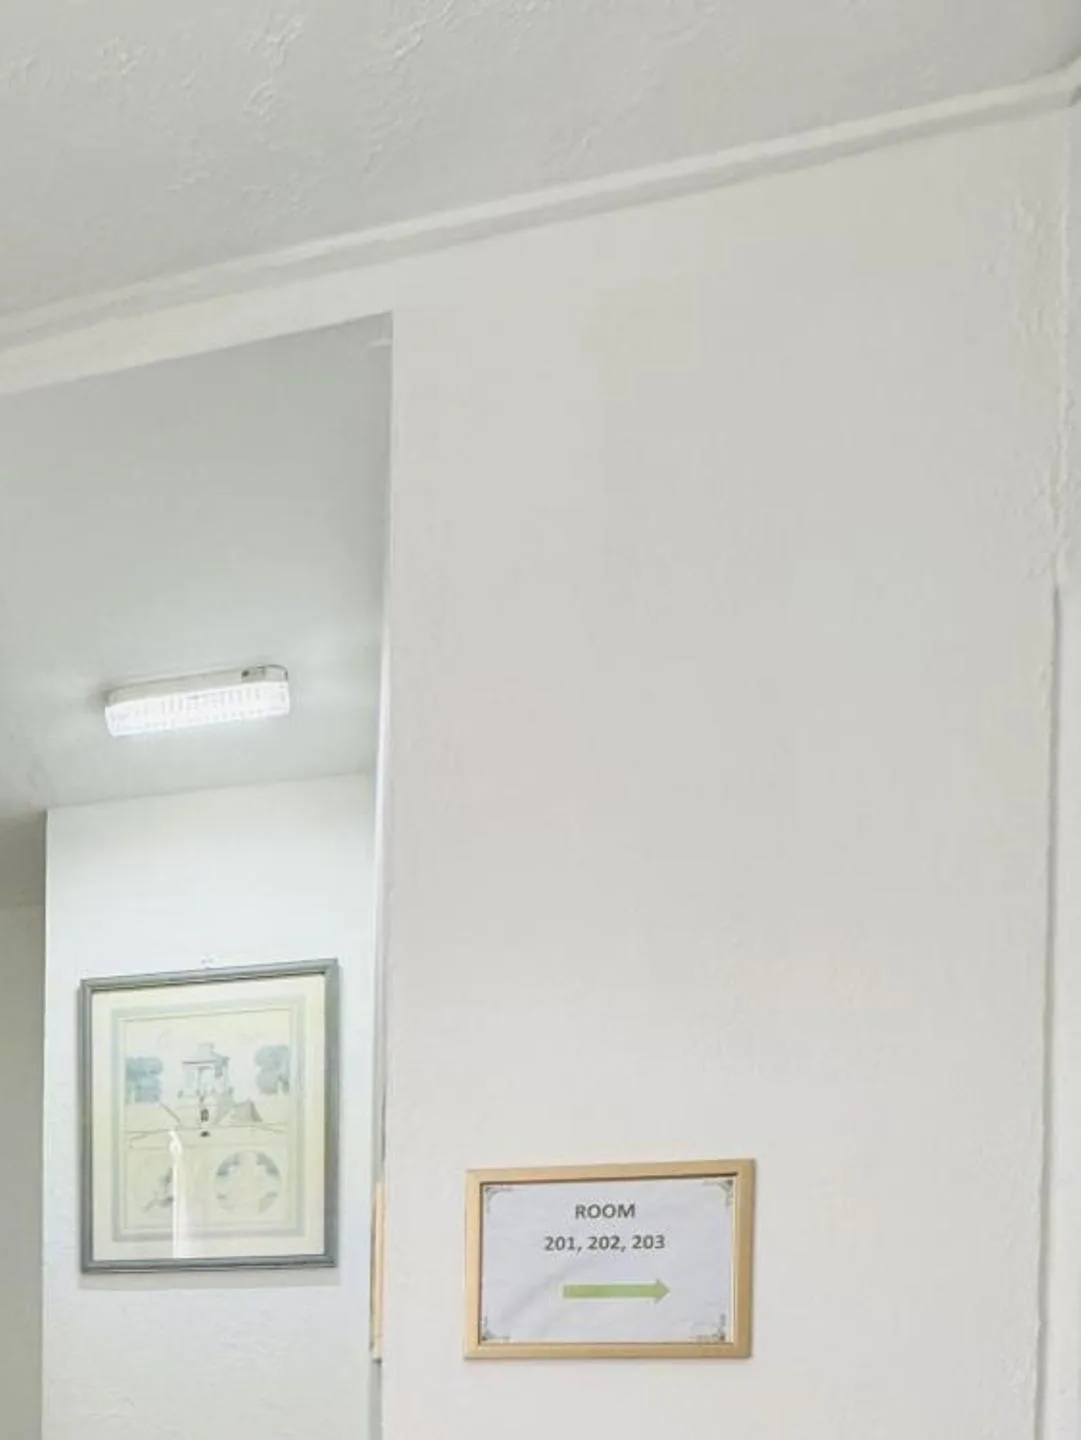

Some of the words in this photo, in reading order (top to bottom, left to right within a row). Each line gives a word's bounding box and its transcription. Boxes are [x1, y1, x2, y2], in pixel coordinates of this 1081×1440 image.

[574, 1203, 636, 1220] ROOM
[544, 1236, 582, 1253] 201,
[587, 1235, 626, 1252] 202,
[631, 1234, 666, 1250] 203
